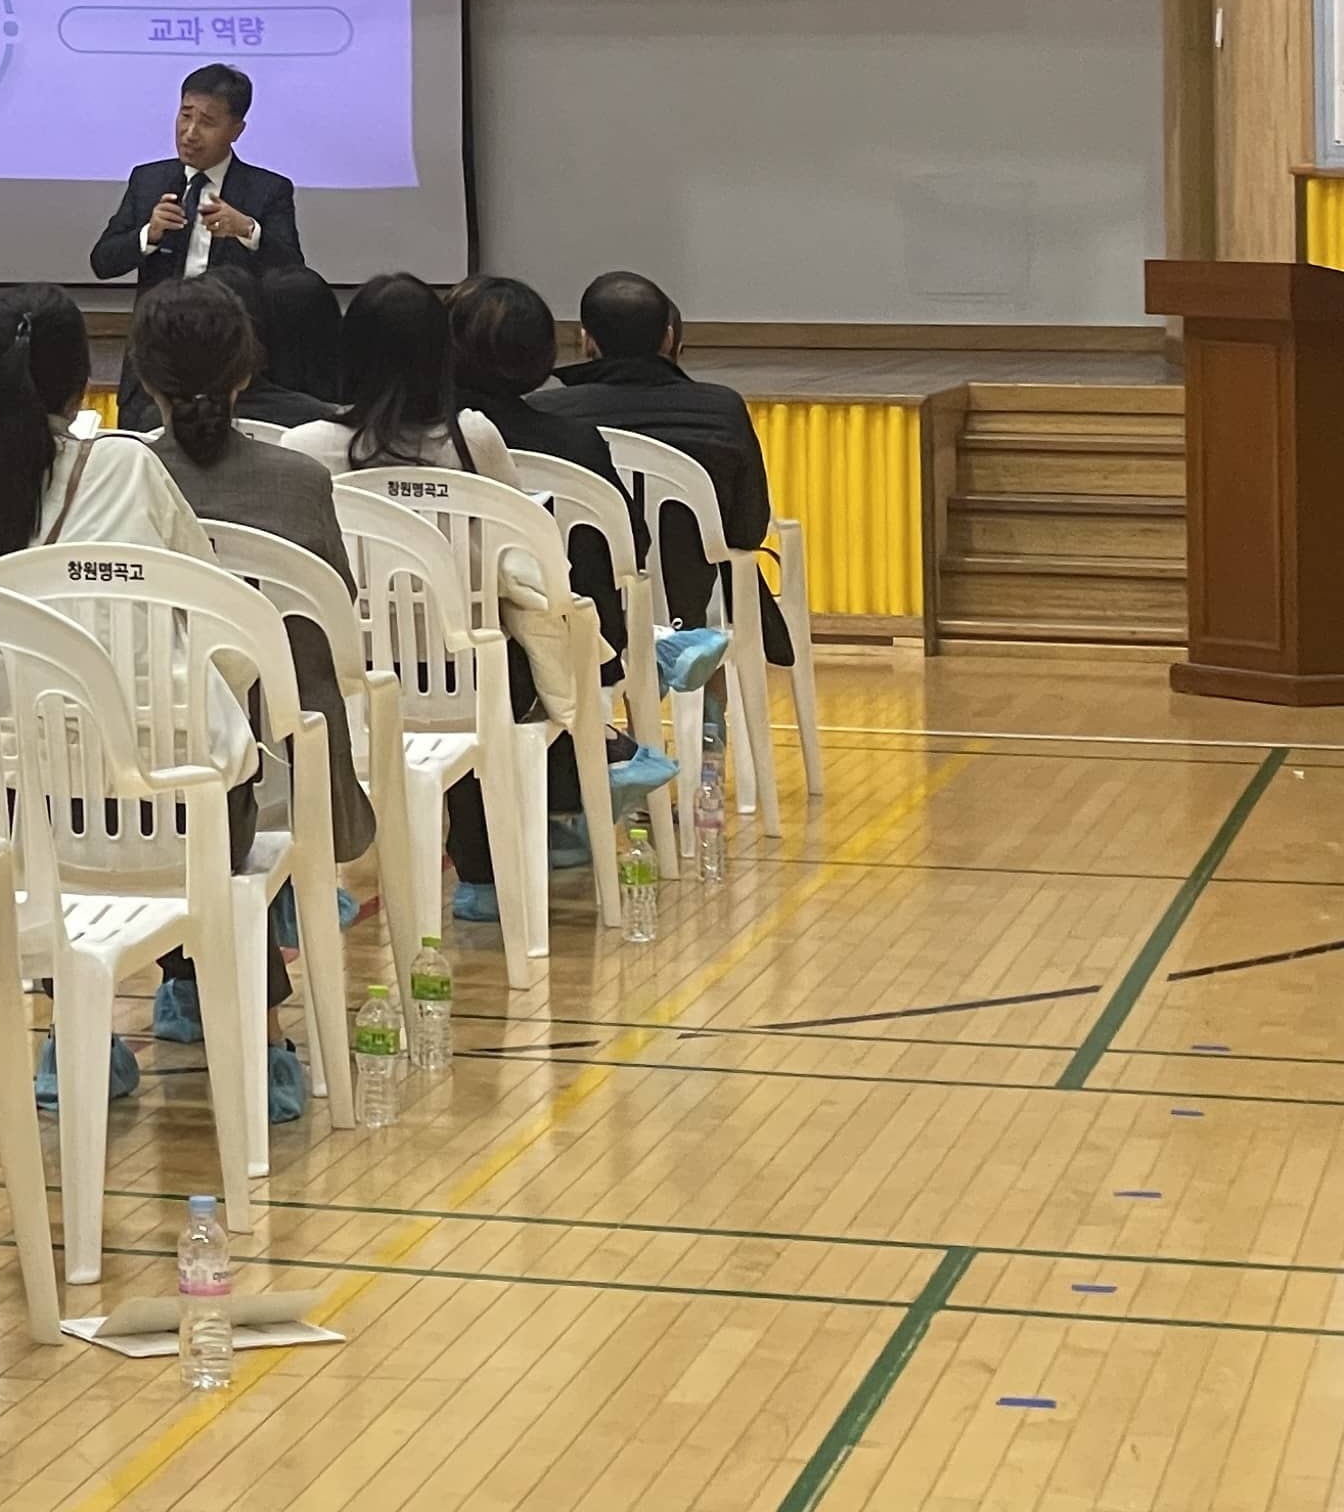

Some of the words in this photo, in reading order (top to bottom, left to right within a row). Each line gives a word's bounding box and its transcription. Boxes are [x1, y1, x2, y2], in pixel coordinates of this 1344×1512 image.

[147, 17, 204, 45] 교과
[210, 15, 265, 46] 역량
[387, 480, 449, 499] 창원명곡고
[66, 560, 145, 584] 창원명곡고
